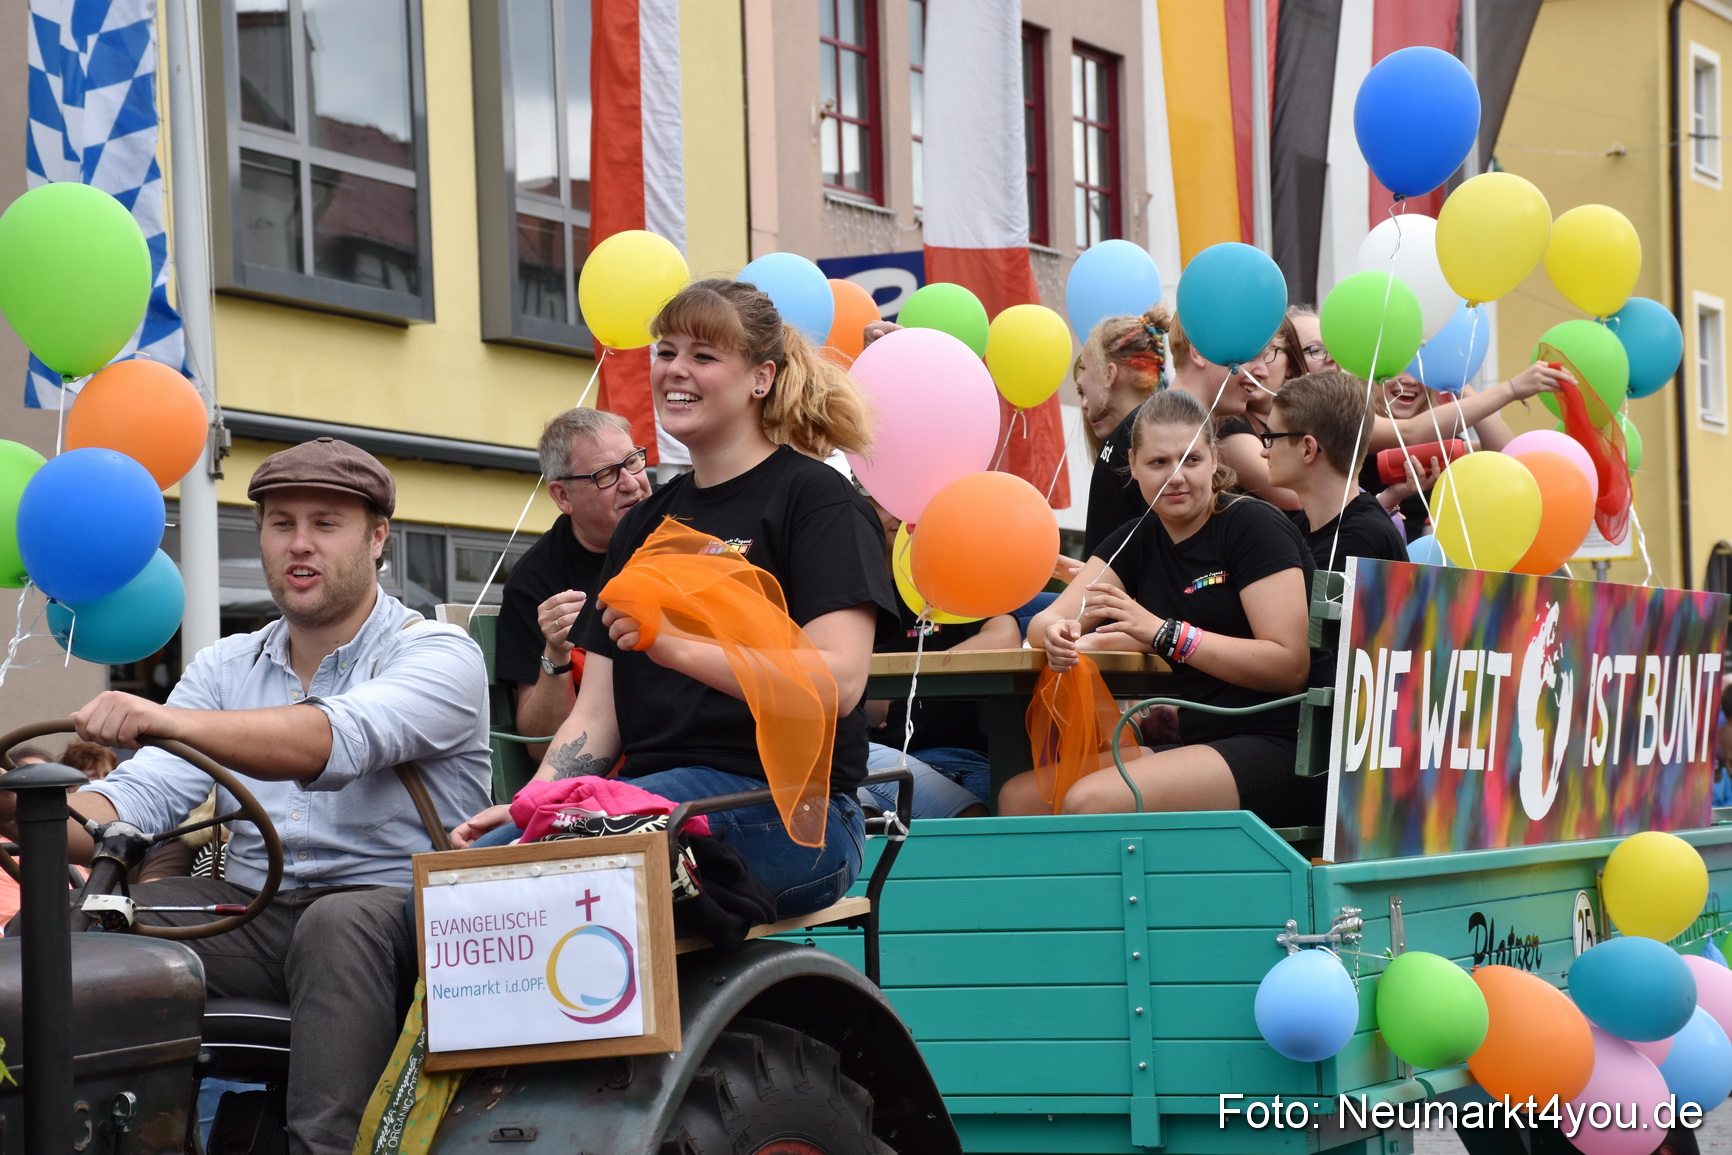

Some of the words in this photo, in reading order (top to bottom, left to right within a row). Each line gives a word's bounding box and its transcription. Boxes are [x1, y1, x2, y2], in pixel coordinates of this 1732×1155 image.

[1346, 648, 1412, 772] DIE
[1420, 649, 1512, 771] WELT
[1583, 653, 1637, 767] IST
[1637, 653, 1722, 766] BUNT
[430, 910, 548, 937] EVANGELISCHE
[1577, 907, 1594, 954] 25
[430, 934, 534, 969] JUGEND
[432, 979, 501, 1000] Neumarkt
[505, 977, 546, 993] i.d.OPF.
[387, 1098, 414, 1148] ORGANIC
